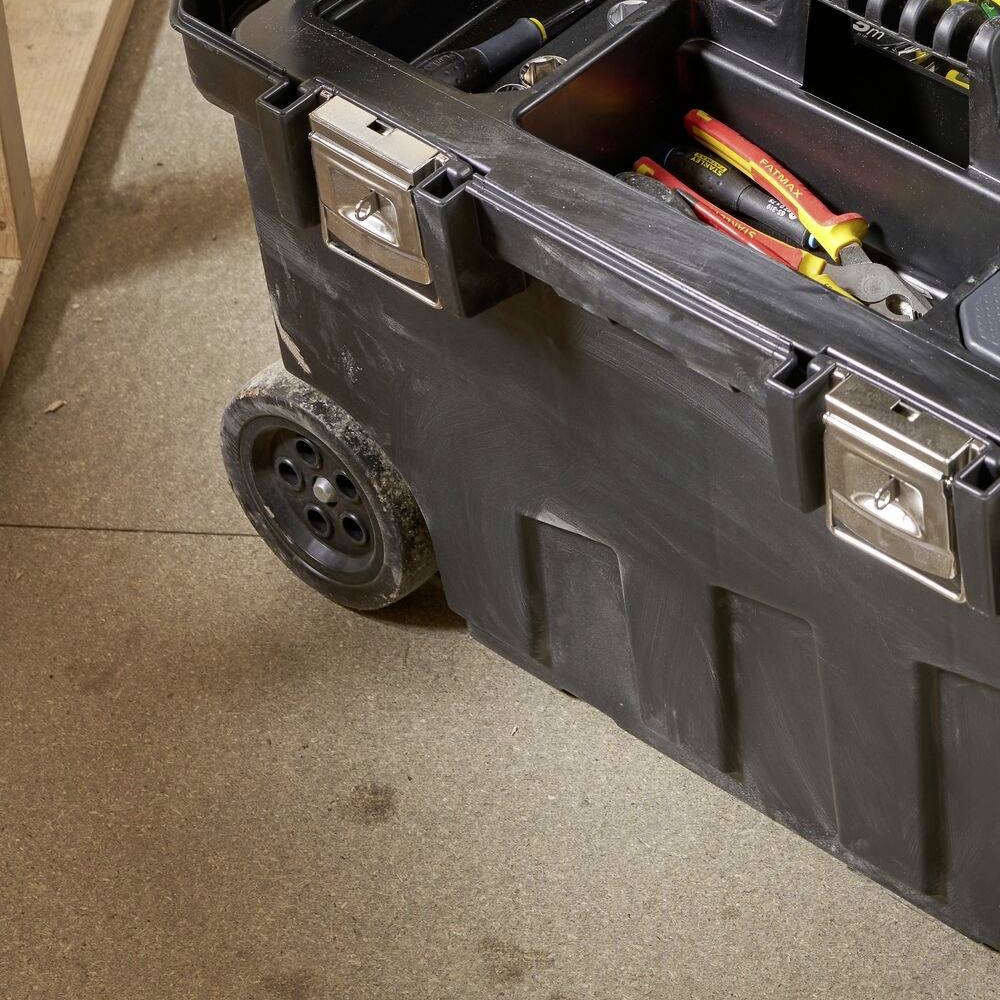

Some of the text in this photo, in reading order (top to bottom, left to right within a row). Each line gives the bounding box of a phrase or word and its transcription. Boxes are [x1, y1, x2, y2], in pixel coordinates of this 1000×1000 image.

[690, 156, 725, 177] STANLEY
[760, 158, 803, 199] FATMAX
[766, 204, 786, 217] 65-319
